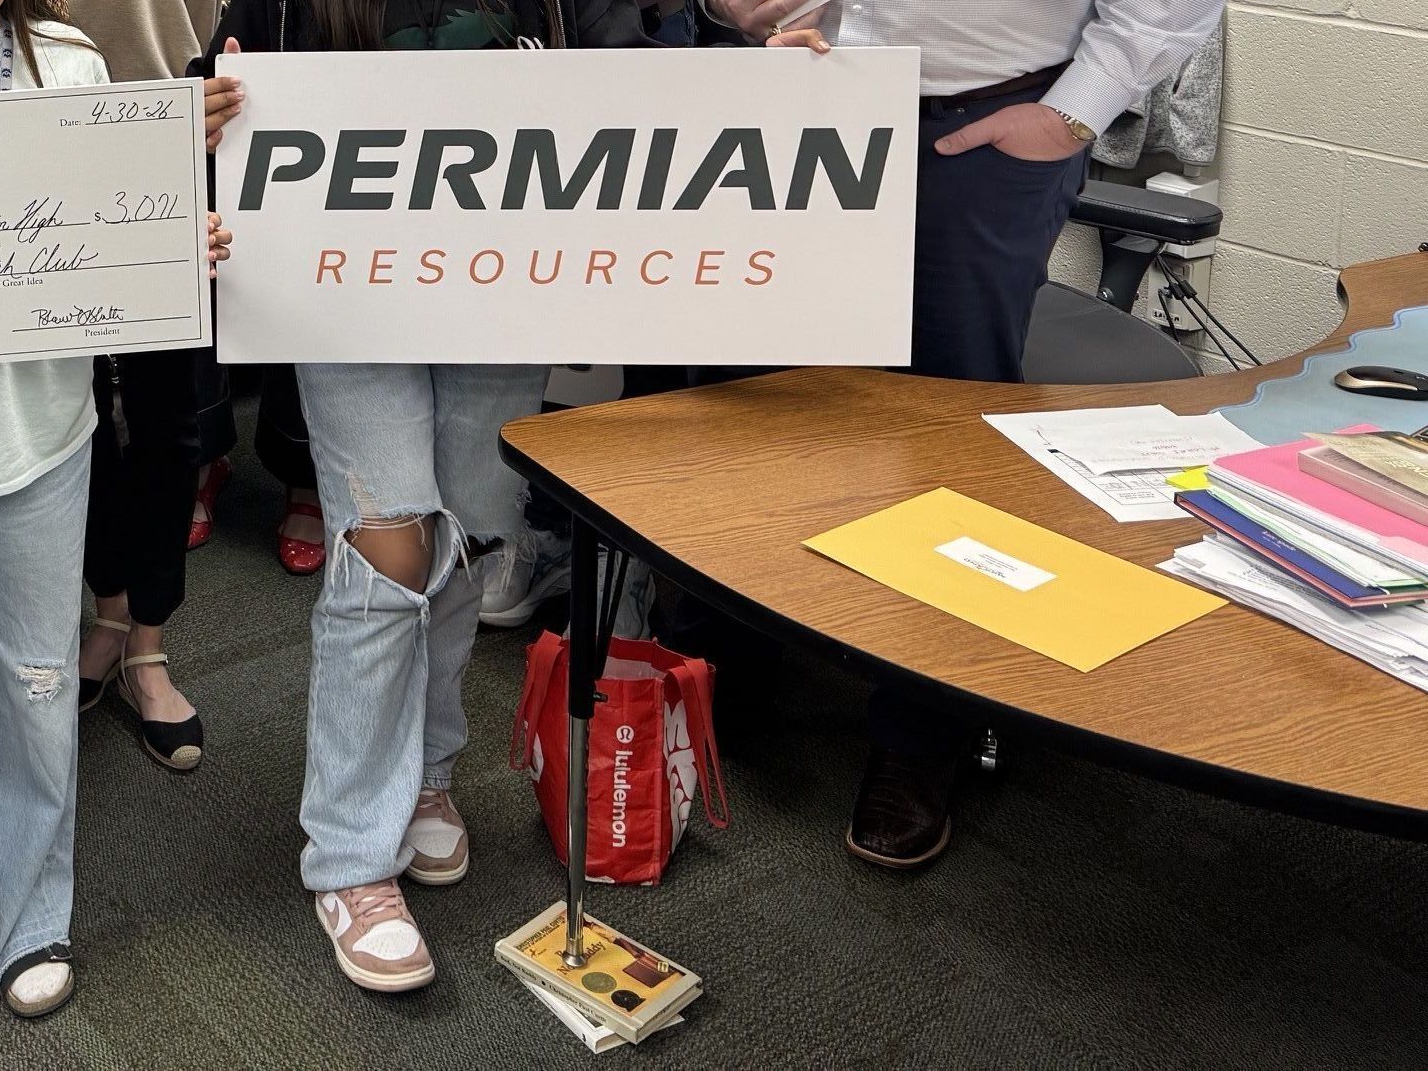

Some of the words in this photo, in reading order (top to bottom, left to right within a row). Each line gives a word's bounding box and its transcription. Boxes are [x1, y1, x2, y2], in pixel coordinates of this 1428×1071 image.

[60, 118, 82, 127] Date:
[91, 100, 174, 124] 4-30-26
[237, 127, 894, 211] PERMIAN
[13, 197, 65, 243] High
[29, 244, 99, 274] Club
[315, 249, 777, 286] RESOURCES
[2, 279, 25, 288] Great
[27, 277, 43, 286] Idea
[85, 327, 120, 338] President
[612, 749, 633, 847] lululemon
